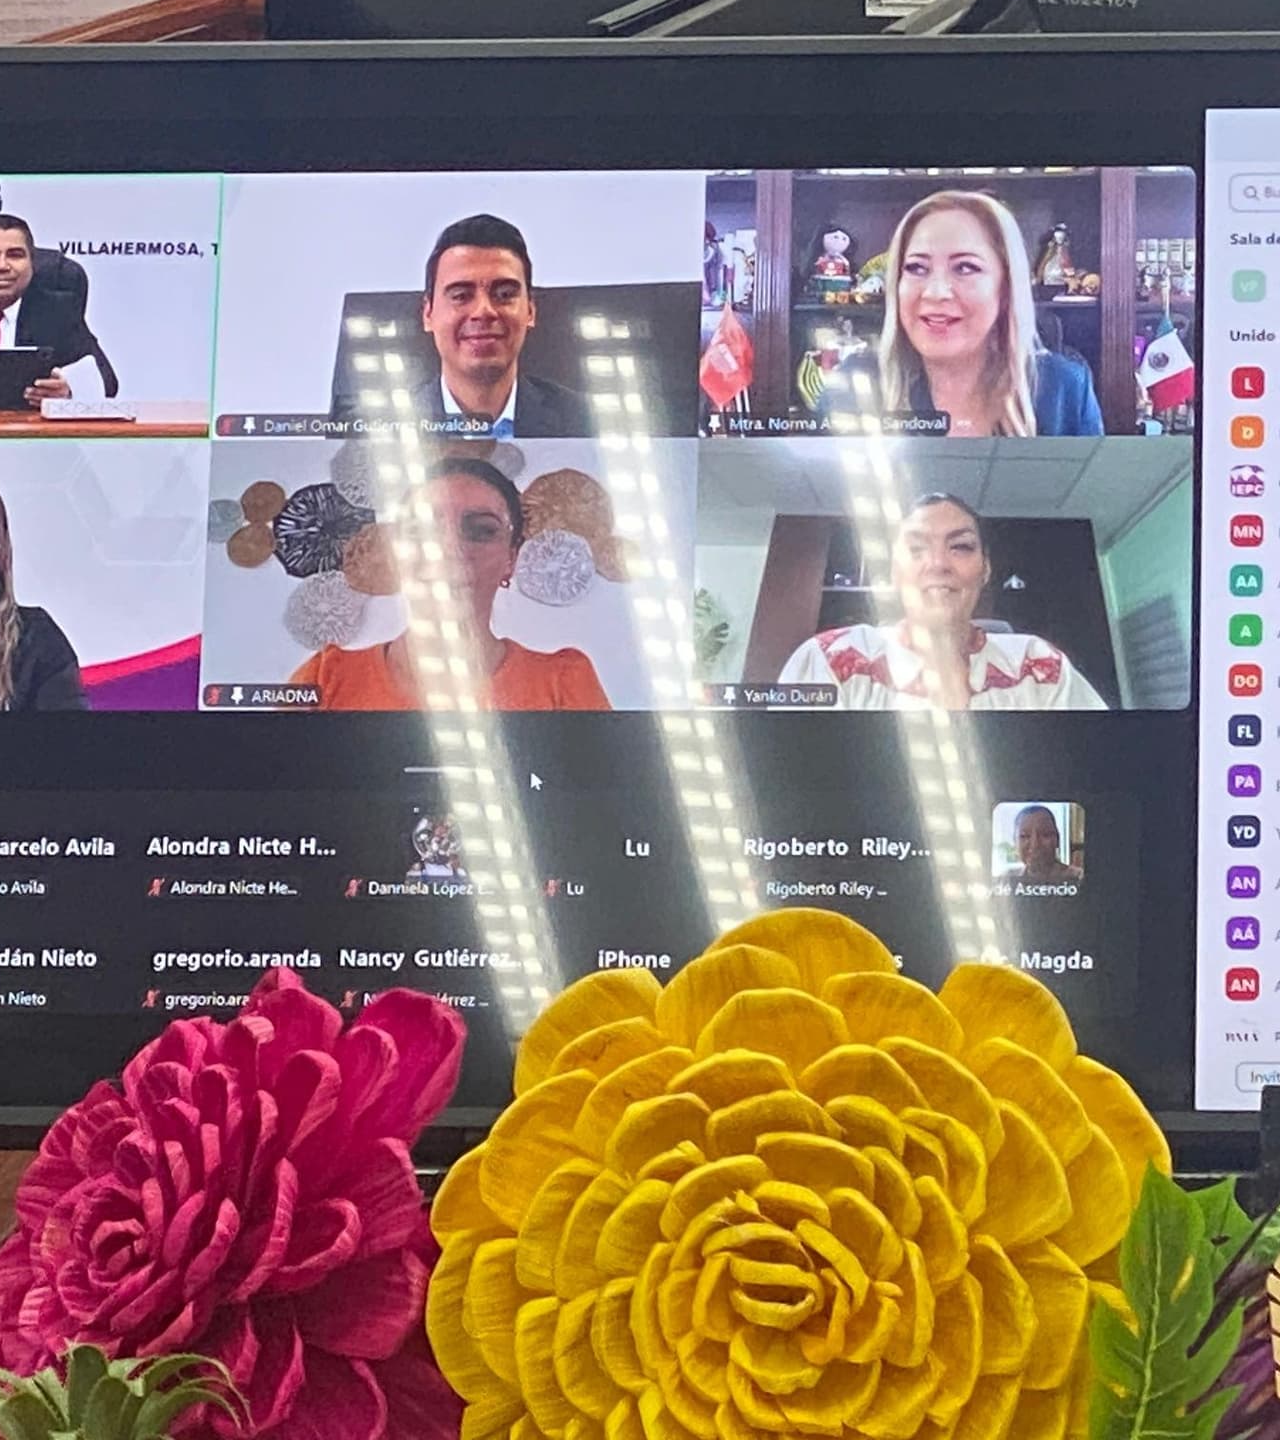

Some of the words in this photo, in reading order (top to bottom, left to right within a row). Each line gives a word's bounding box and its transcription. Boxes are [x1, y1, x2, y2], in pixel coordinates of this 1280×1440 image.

[59, 240, 204, 258] VILLAHERMOSA,
[1230, 232, 1261, 246] Sala
[1229, 329, 1276, 343] Unido
[420, 419, 490, 433] Ruvalcaba
[882, 416, 948, 431] Sandoval
[251, 688, 319, 704] ARIADNA
[742, 687, 787, 704] Yanko
[790, 687, 833, 704] Durán
[64, 837, 116, 857] Avila
[146, 836, 230, 857] Alondra
[238, 836, 292, 857] Nicte
[625, 838, 650, 858] Lu
[742, 837, 849, 862] Rigoberto
[40, 948, 97, 968] Nieto
[152, 950, 322, 972] gregorio.aranda
[597, 950, 671, 970] iPhone
[1019, 951, 1094, 974] Magda
